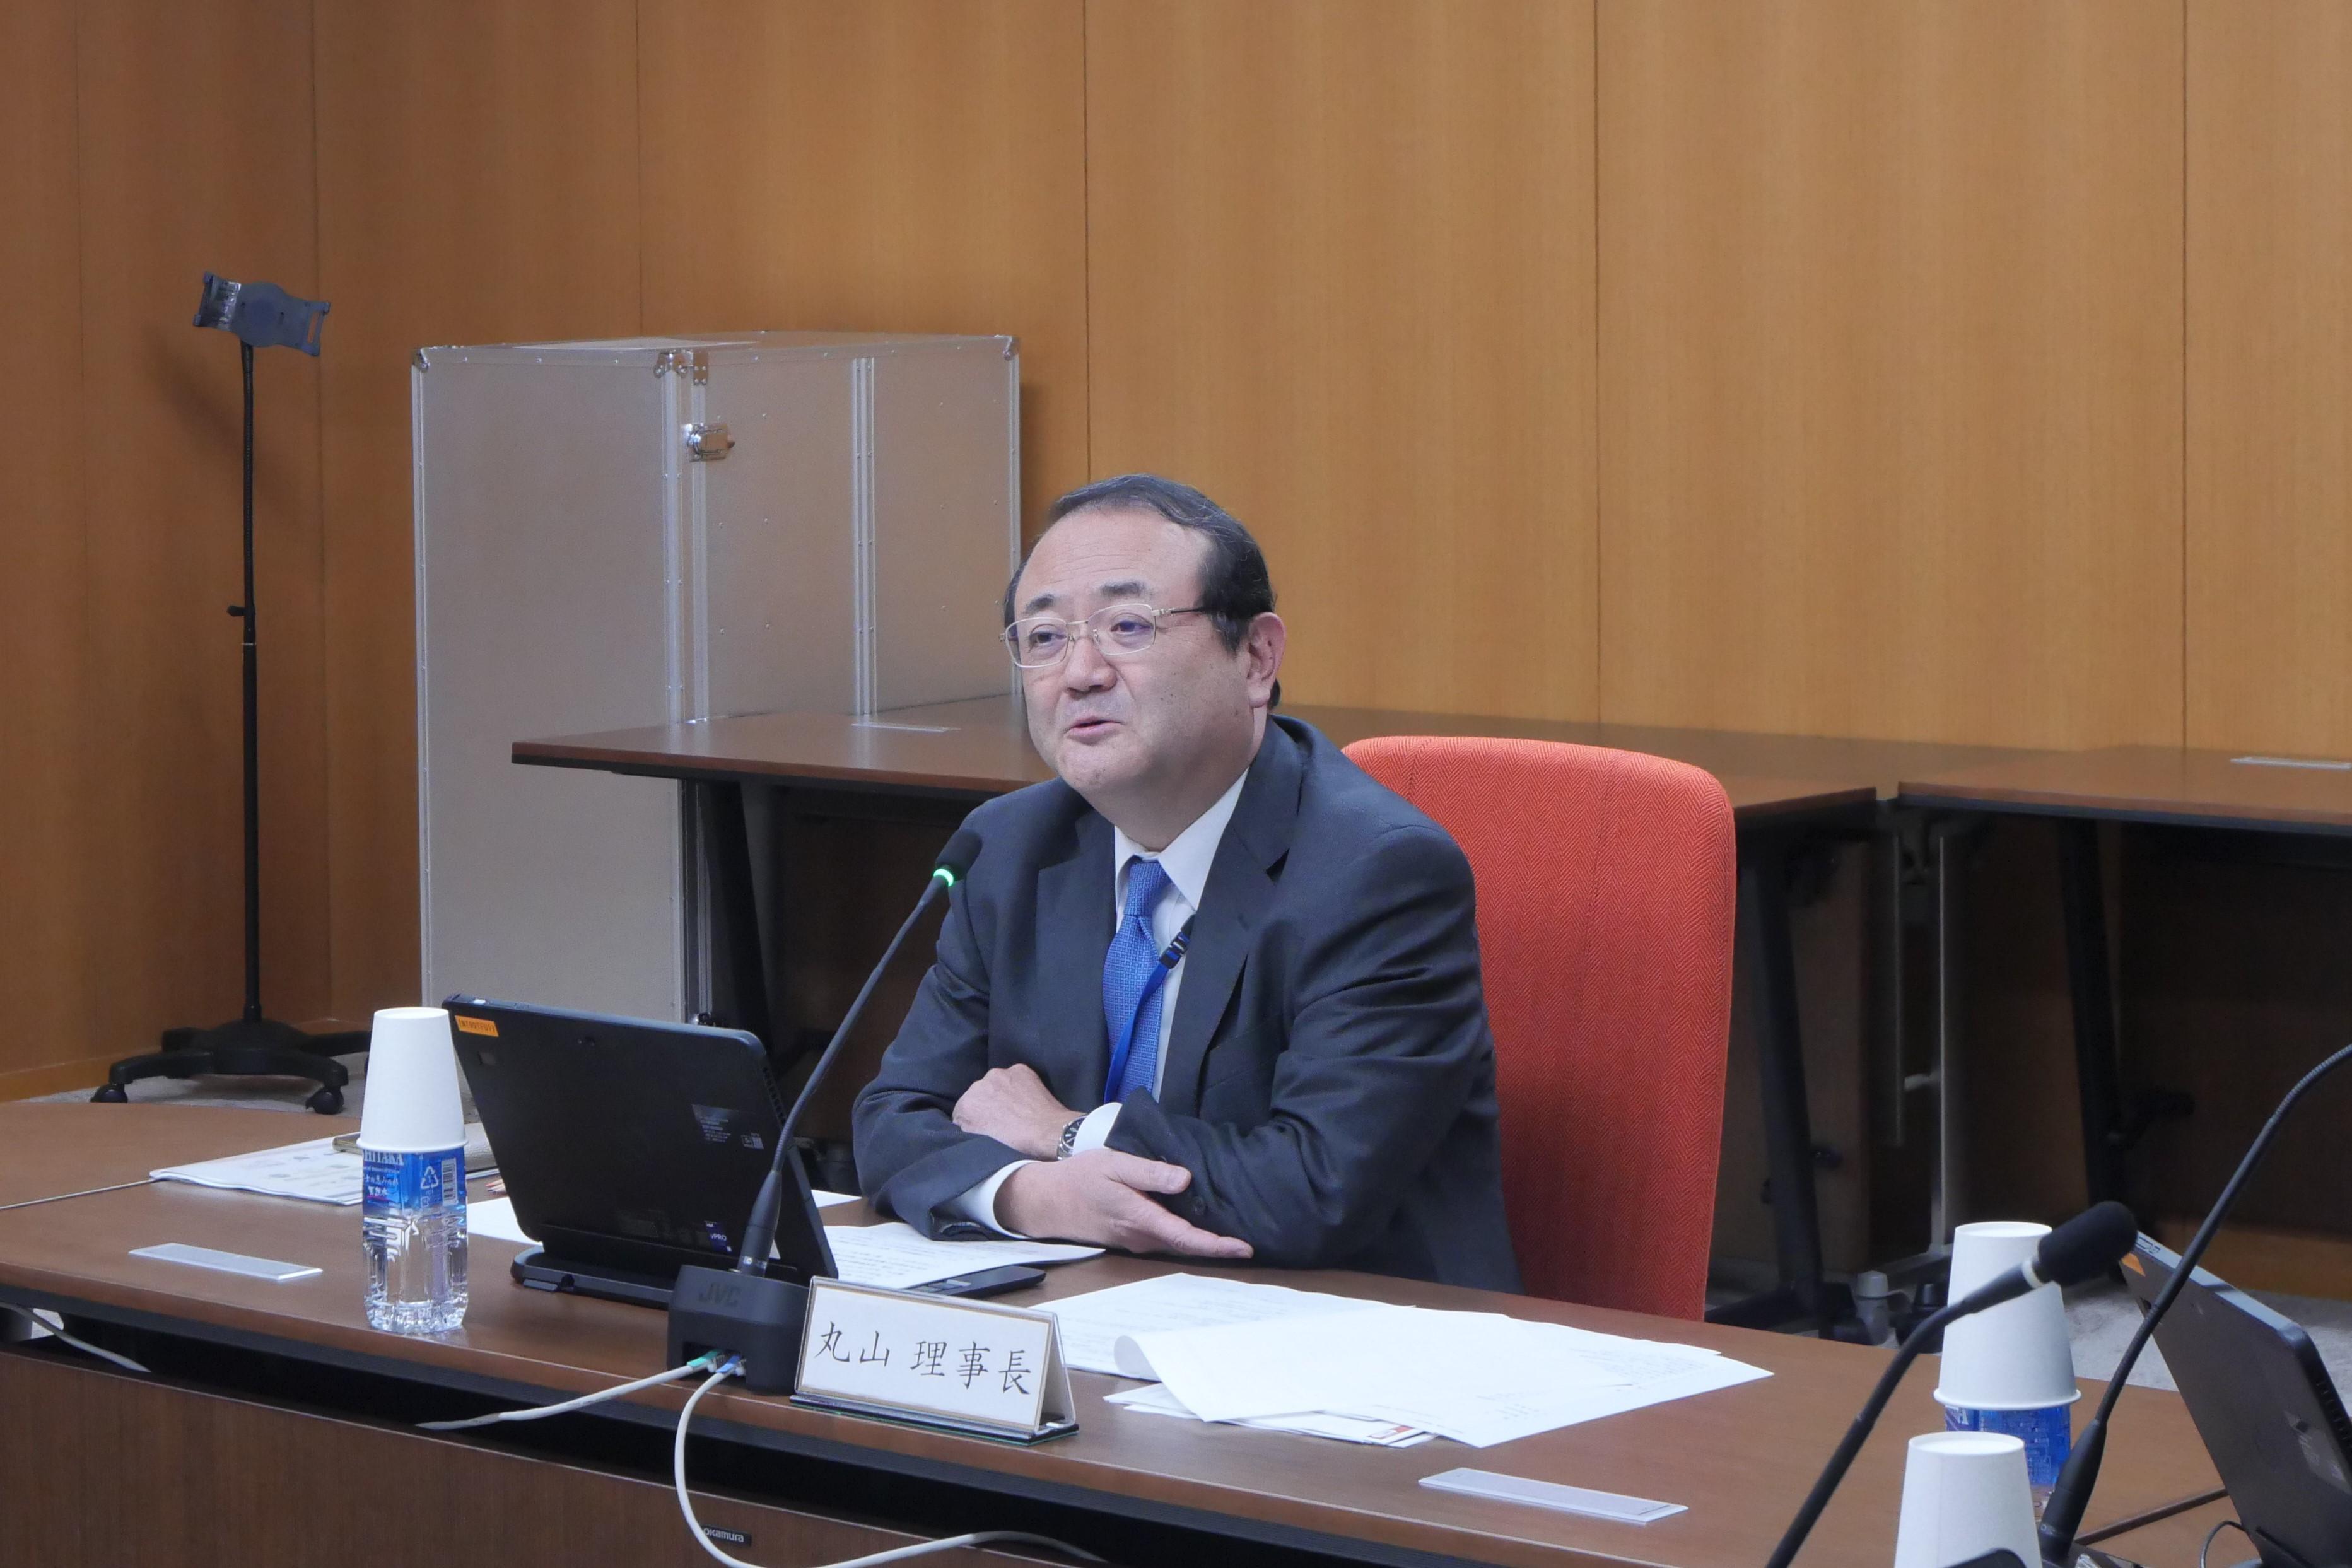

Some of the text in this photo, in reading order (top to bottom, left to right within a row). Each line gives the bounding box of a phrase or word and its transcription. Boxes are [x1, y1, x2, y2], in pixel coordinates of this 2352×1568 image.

[814, 1321, 1032, 1395] 丸山 理事長
